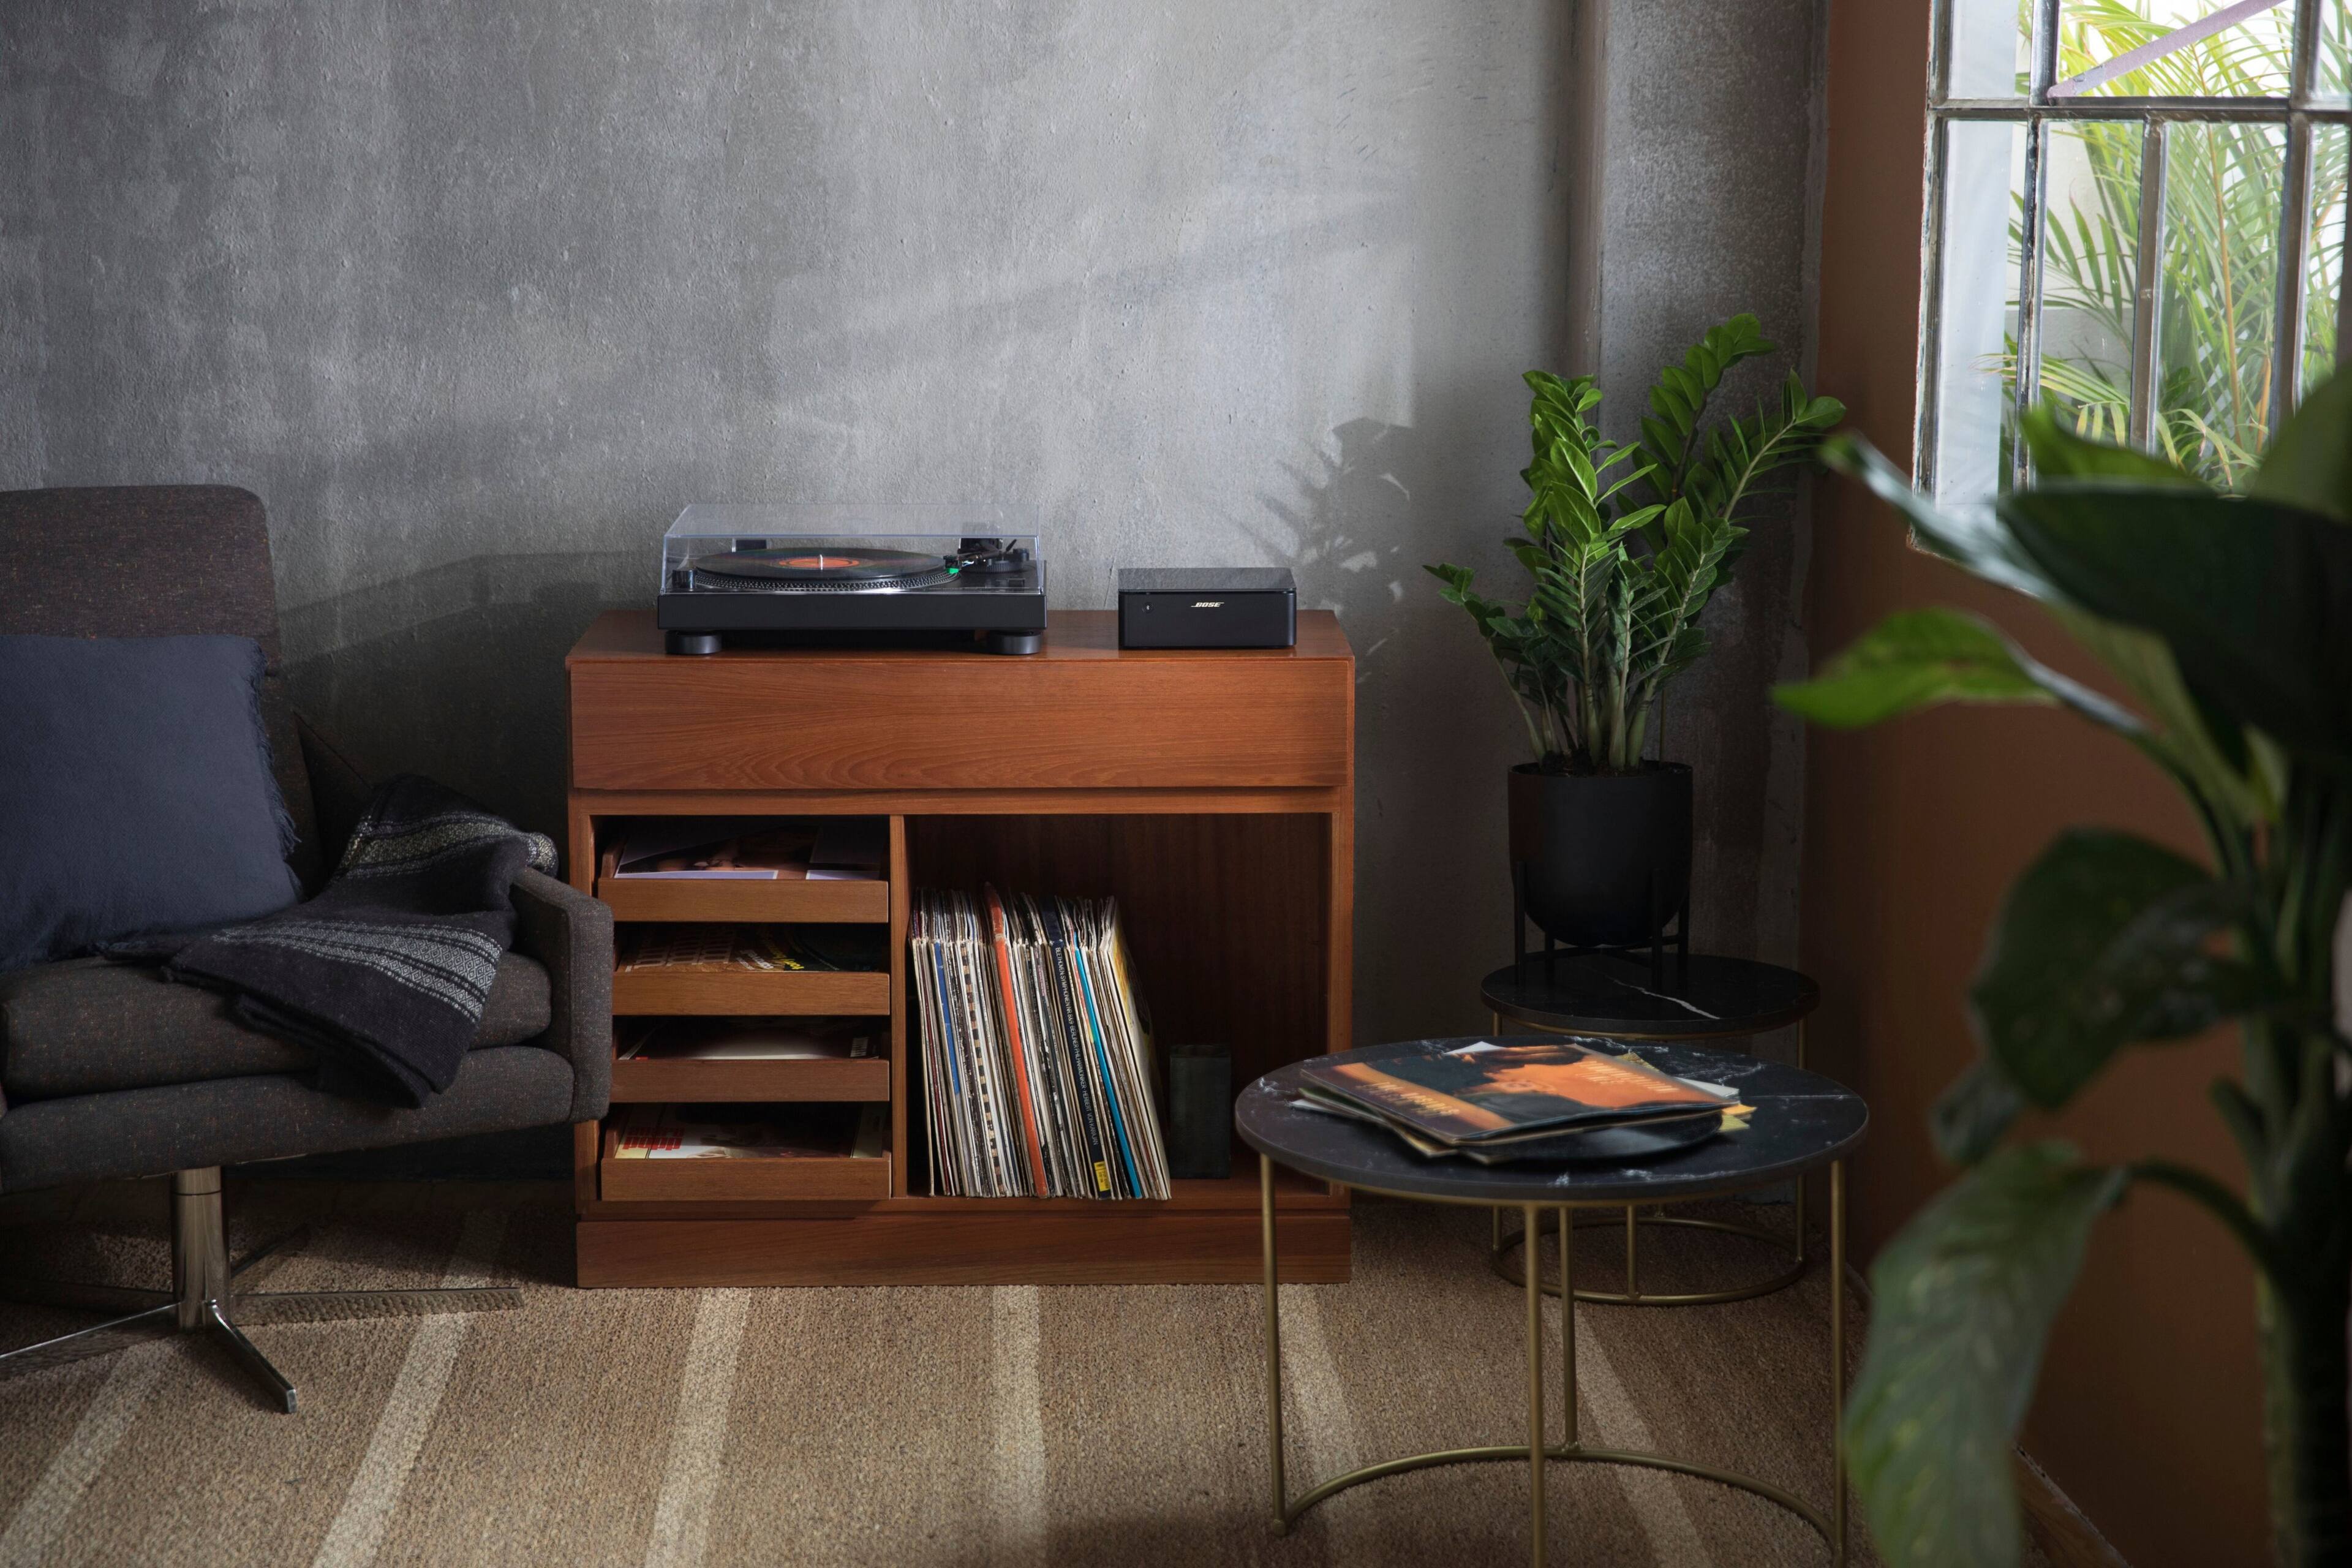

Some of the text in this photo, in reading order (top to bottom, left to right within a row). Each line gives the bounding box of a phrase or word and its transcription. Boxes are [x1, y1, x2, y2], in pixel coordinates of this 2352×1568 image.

[1070, 1025, 1079, 1049] BERLINER
[1082, 1091, 1091, 1112] HERBERT
[1090, 1123, 1099, 1145] KARAJAN
